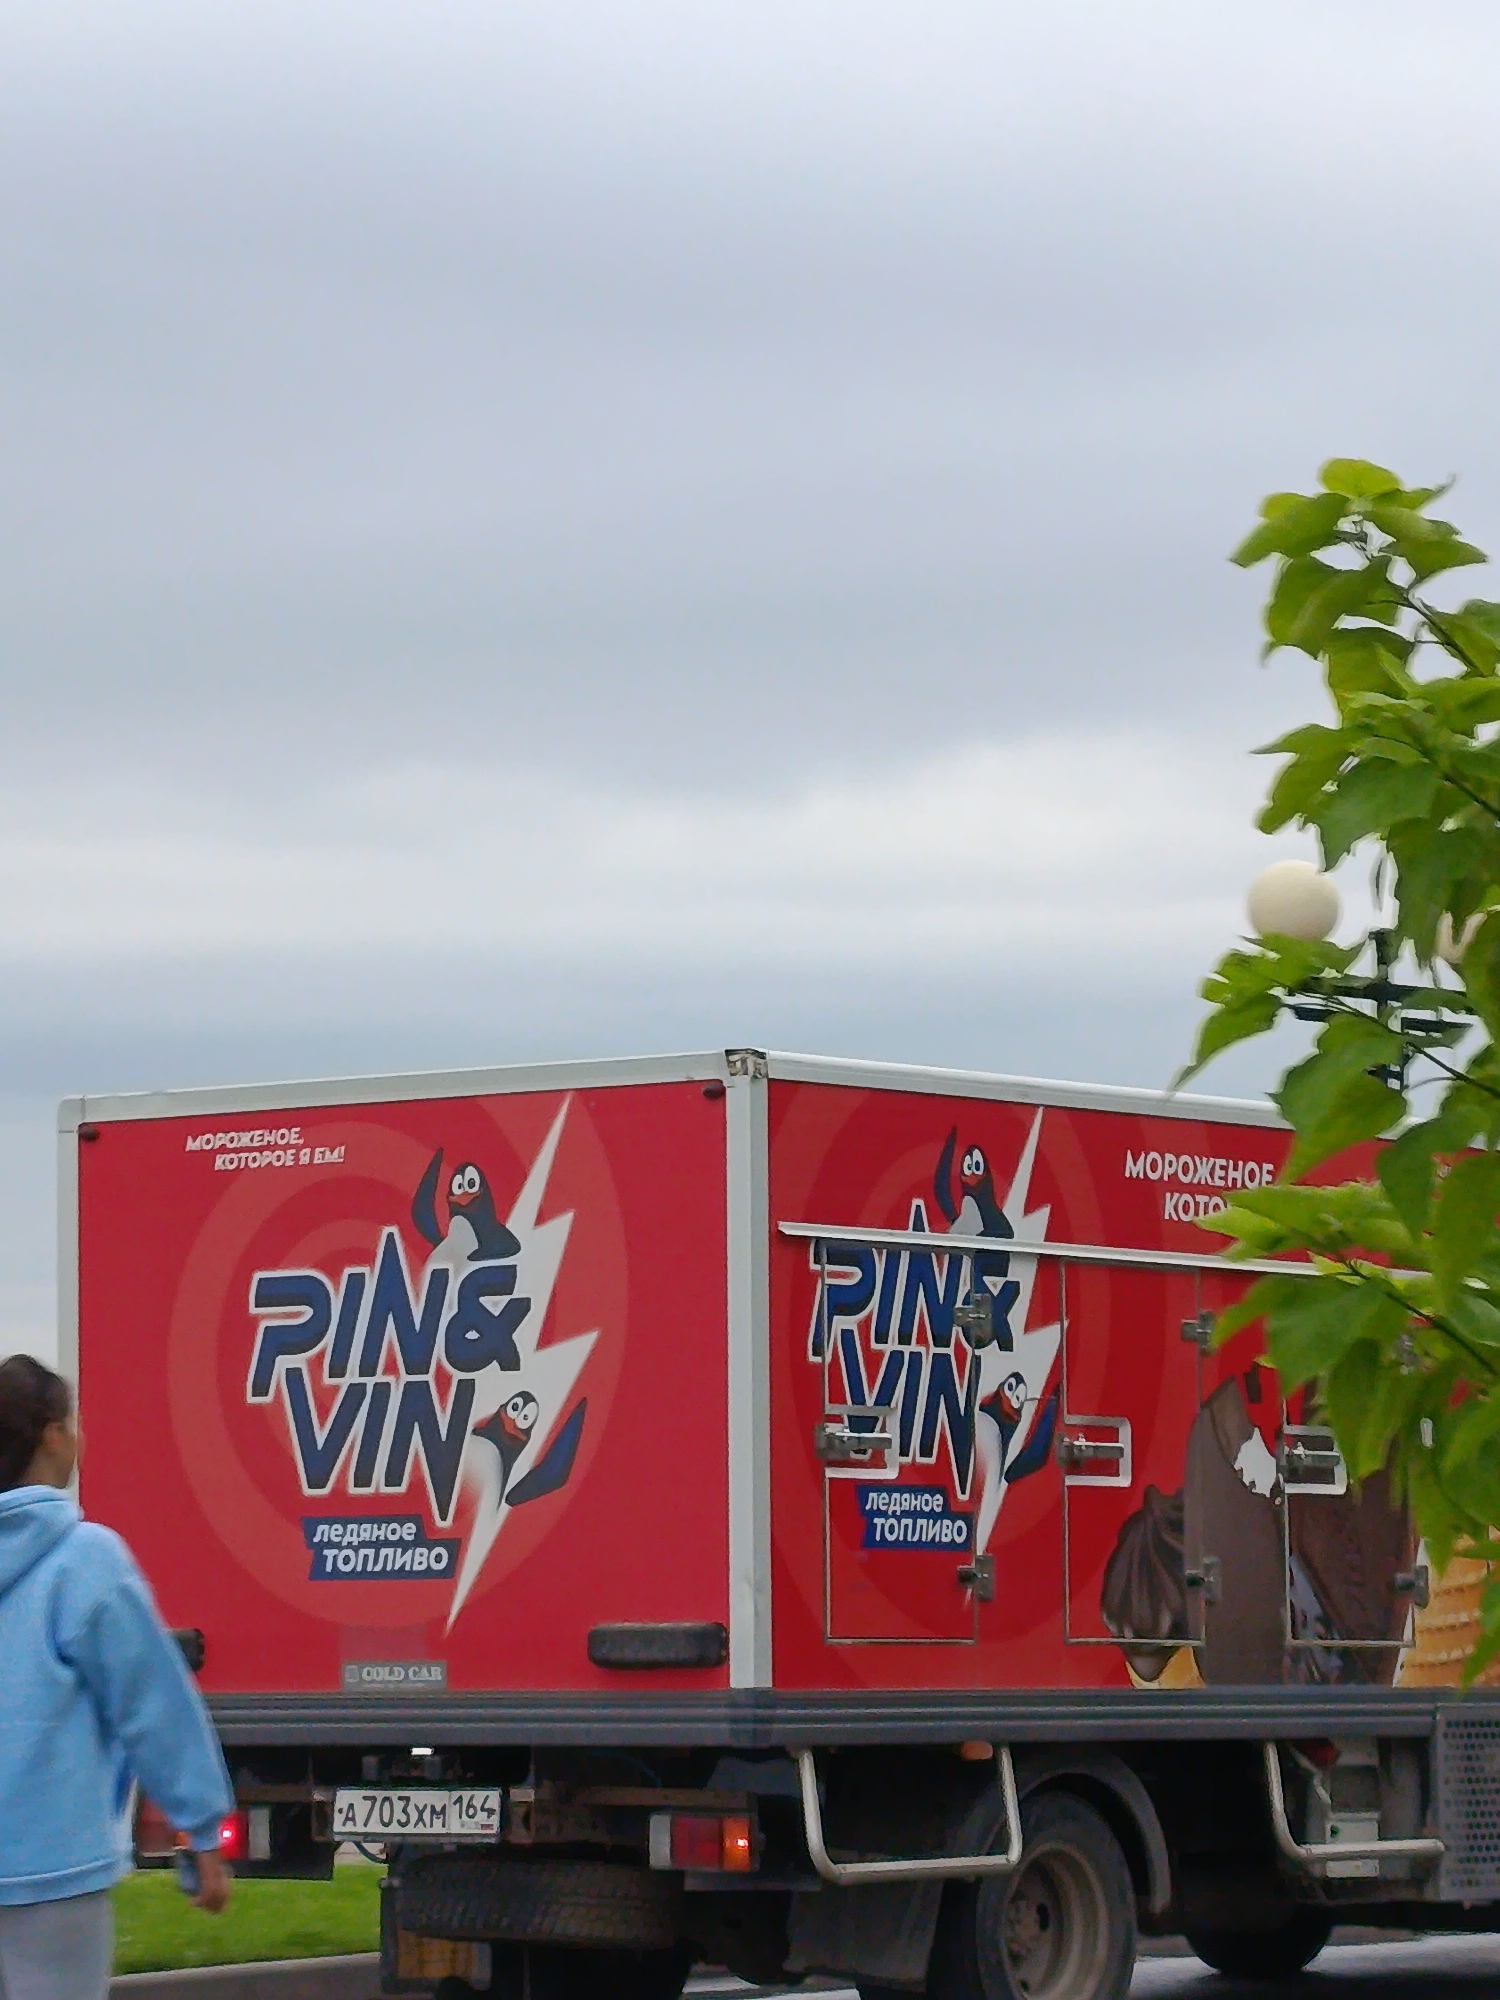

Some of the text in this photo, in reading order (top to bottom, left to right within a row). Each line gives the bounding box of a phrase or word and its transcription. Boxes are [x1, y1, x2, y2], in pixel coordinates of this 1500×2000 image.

[185, 1127, 304, 1151] МОРОЖЕНОЕ,
[215, 1146, 345, 1170] КОТОРОЕ Я ЕМ!
[1164, 1192, 1232, 1221] КОТО
[248, 1226, 533, 1401] PIN&
[838, 1328, 983, 1498] VIN
[280, 1365, 477, 1526] VIN
[866, 1492, 943, 1515] ледяное
[313, 1522, 416, 1546] ледяное
[873, 1517, 968, 1544] ТОПЛИВО
[323, 1547, 449, 1573] ТОПЛИВО
[361, 1666, 442, 1681] COLD CAR
[342, 1794, 497, 1829] А703ХМ 164
